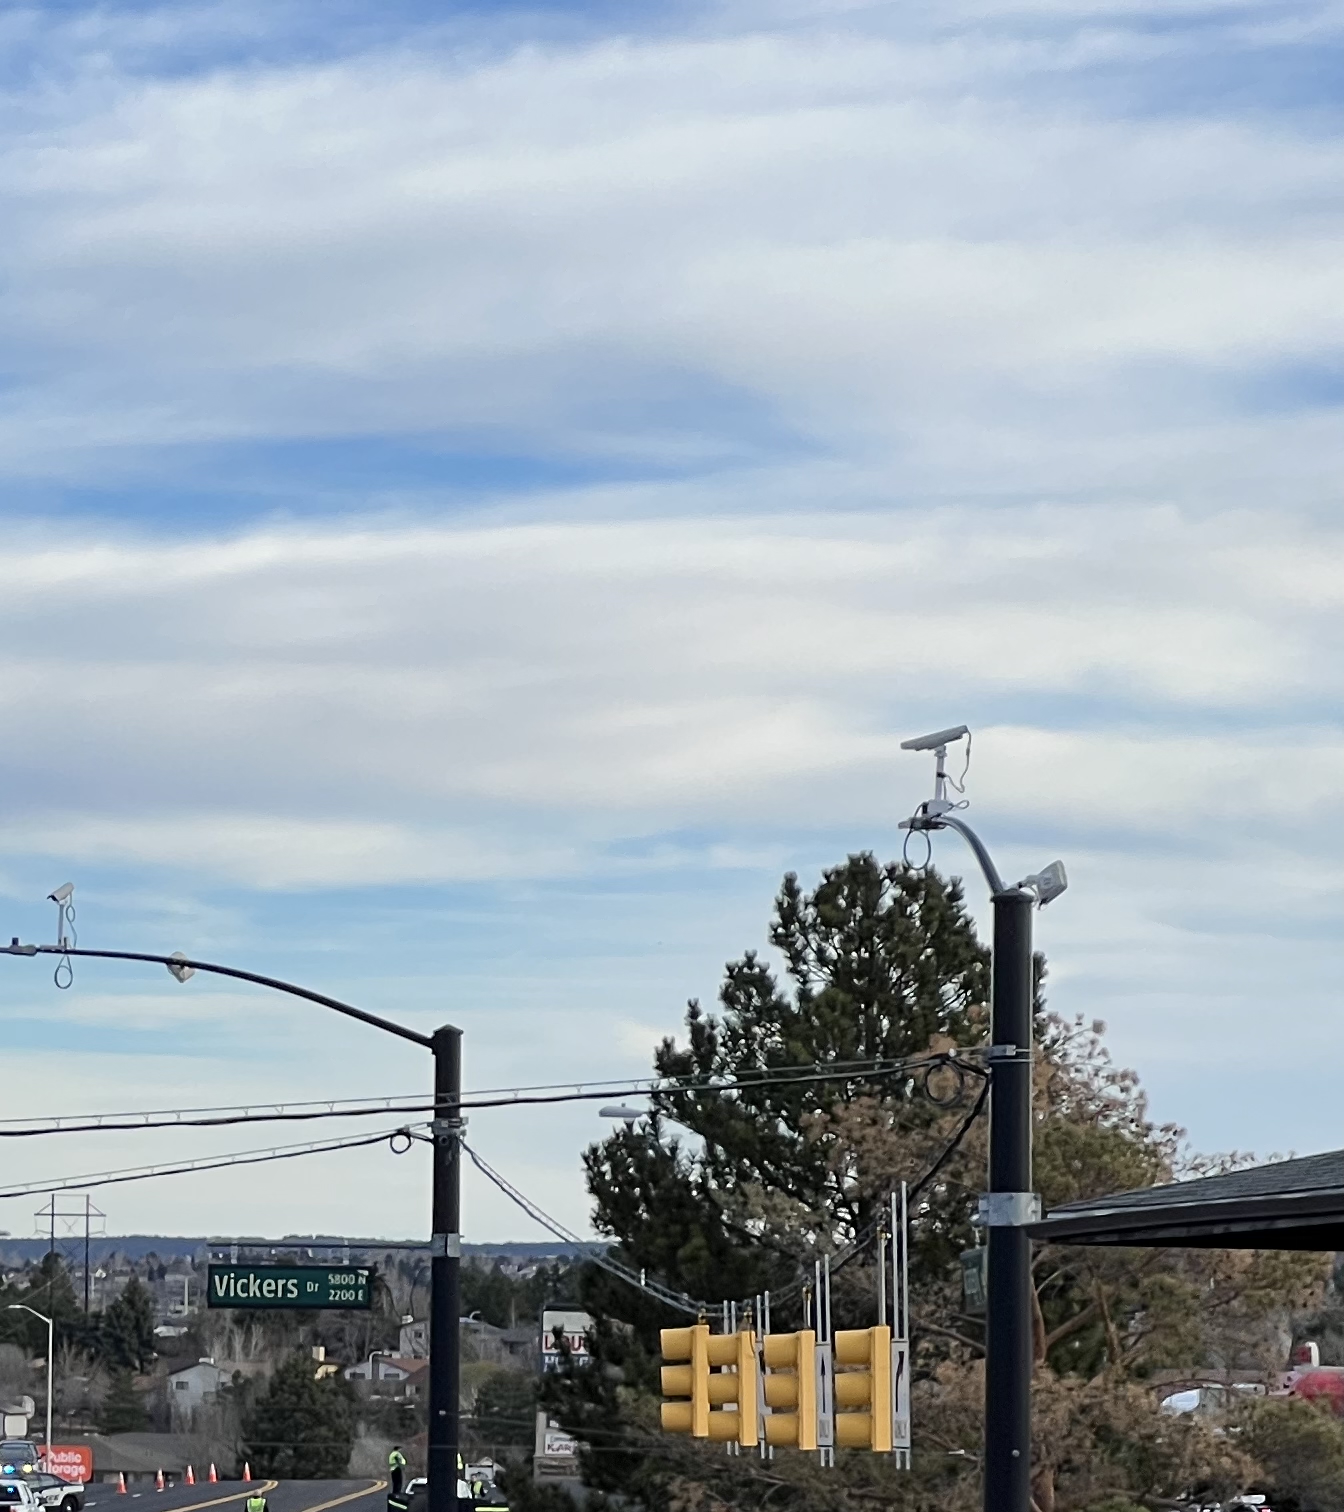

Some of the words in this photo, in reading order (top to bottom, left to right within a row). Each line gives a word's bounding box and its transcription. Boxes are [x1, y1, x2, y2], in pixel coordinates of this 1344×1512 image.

[328, 1273, 355, 1285] 5800
[214, 1273, 298, 1298] Vickers
[307, 1281, 318, 1292] Dr
[328, 1290, 355, 1301] 2200
